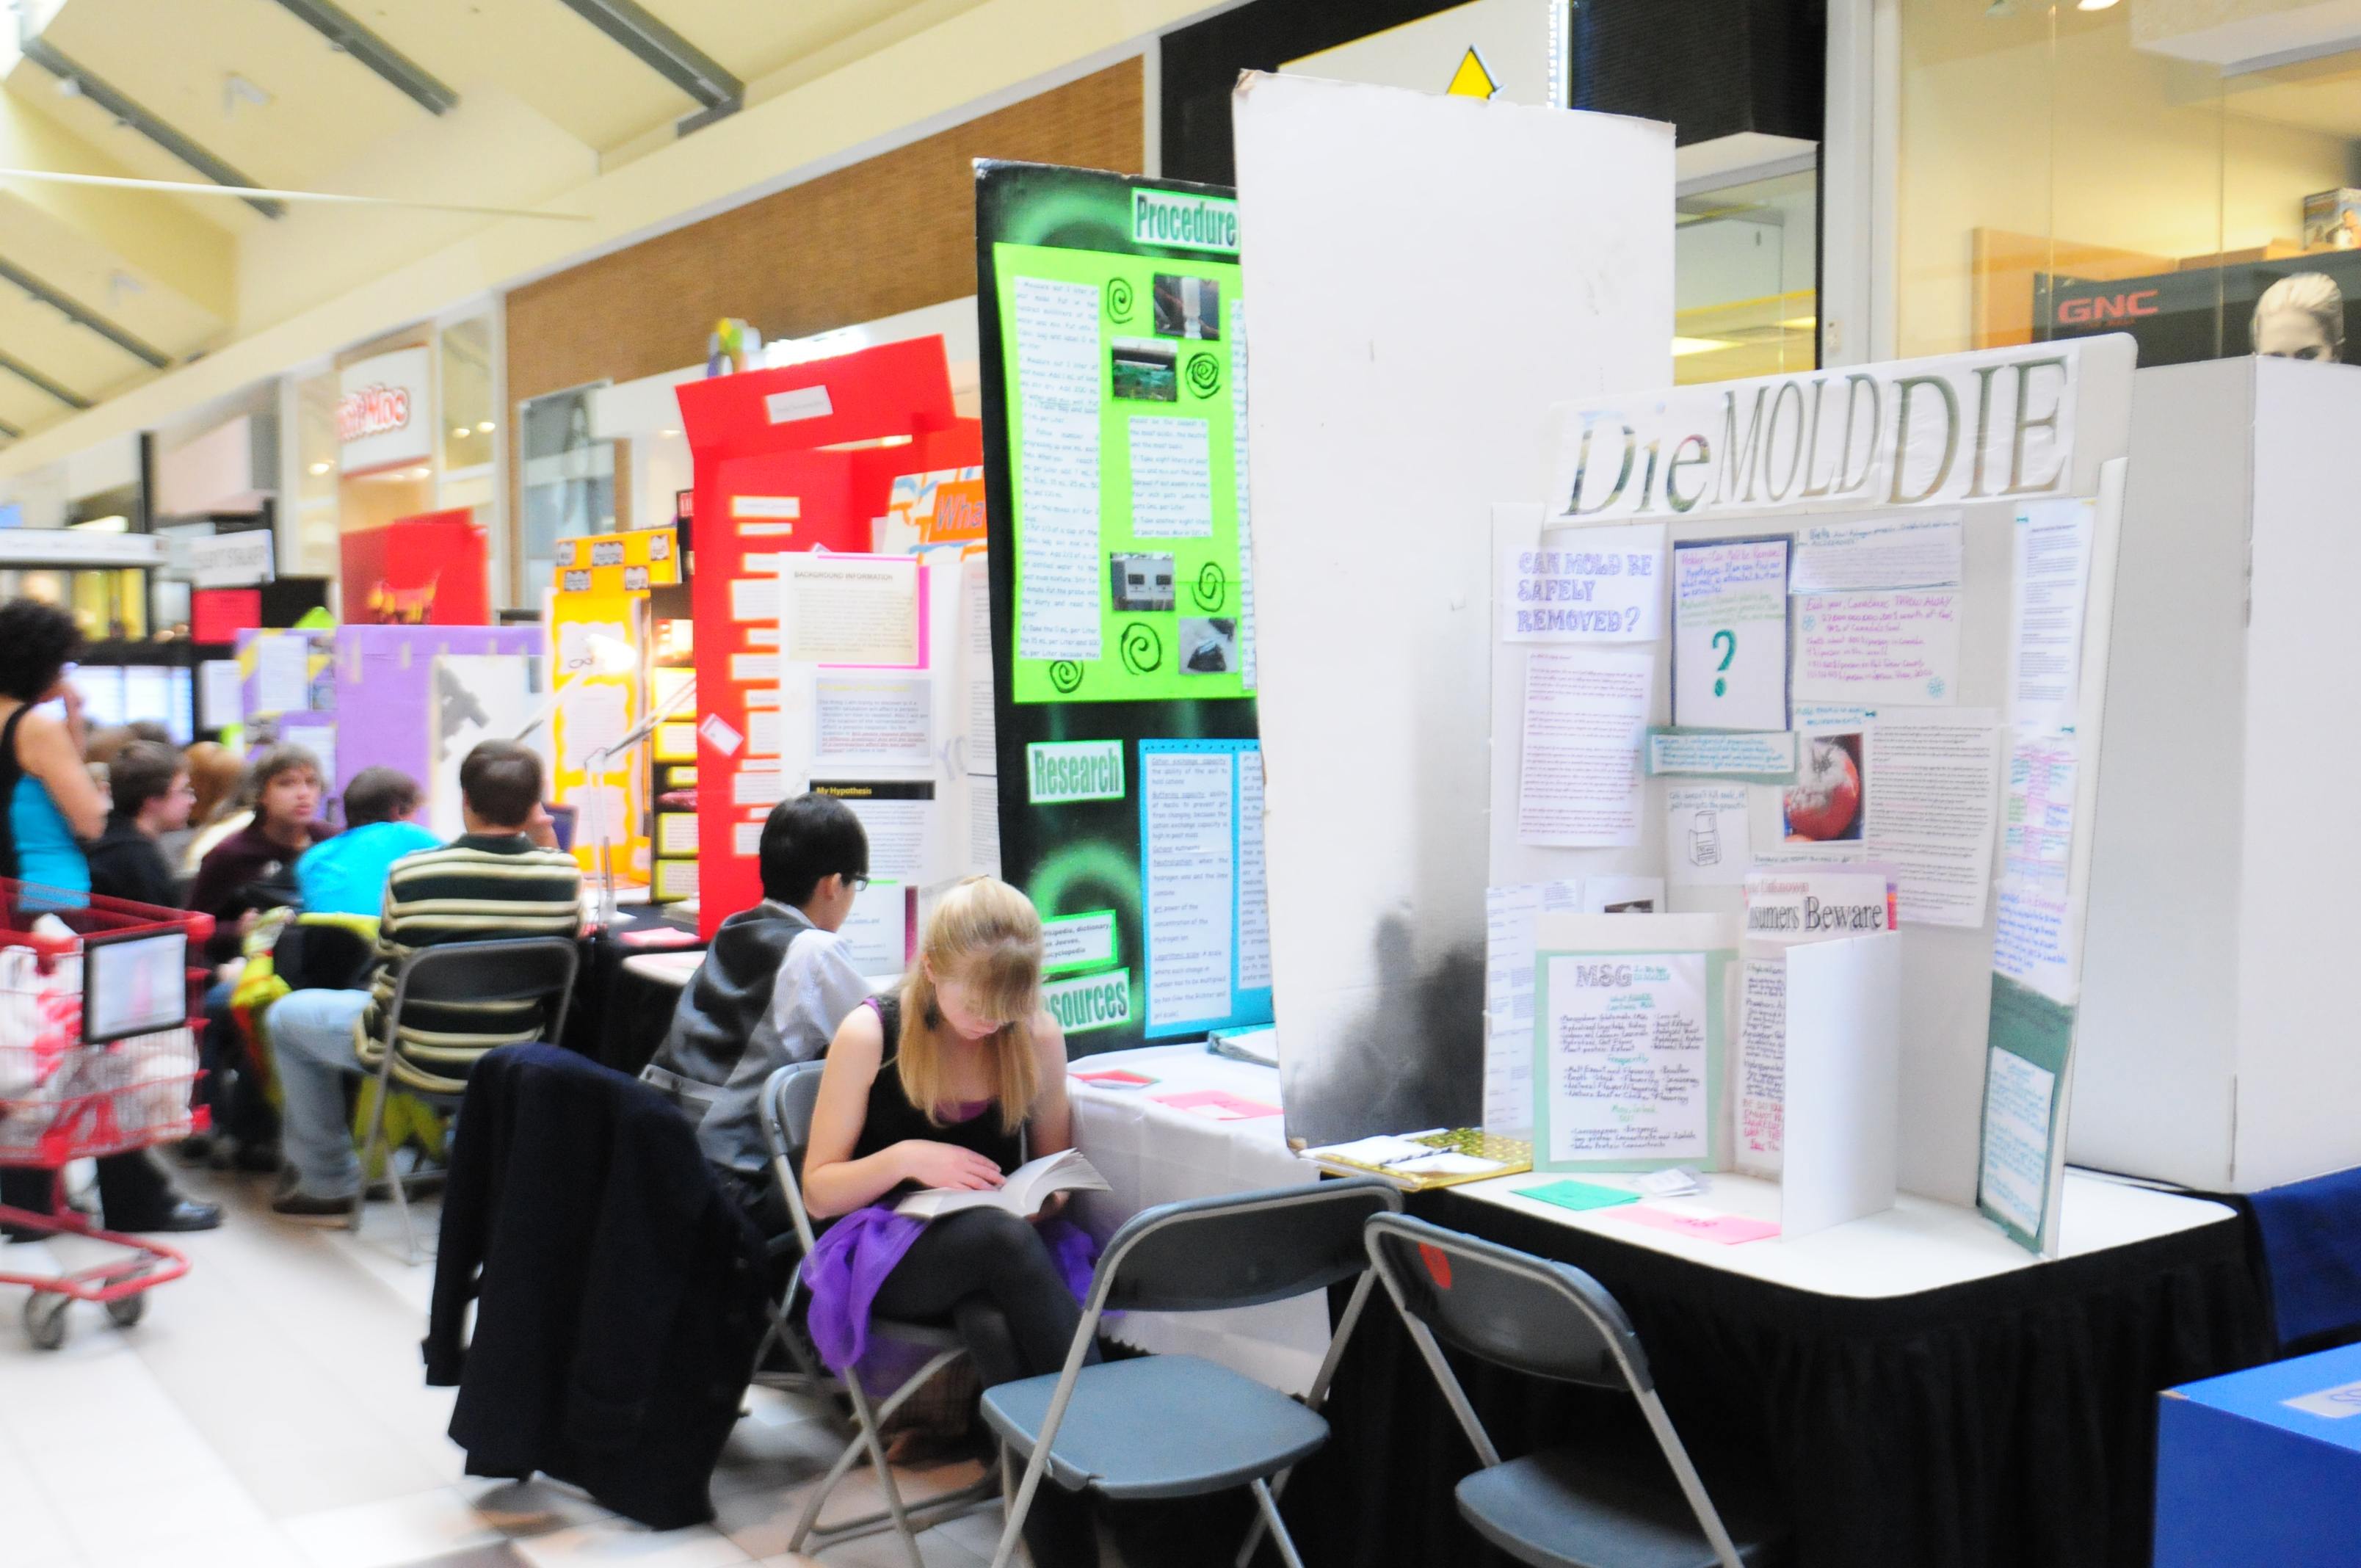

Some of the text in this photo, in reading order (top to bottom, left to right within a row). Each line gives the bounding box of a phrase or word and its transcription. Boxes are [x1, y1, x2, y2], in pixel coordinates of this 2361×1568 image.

[1136, 193, 1236, 247] Procedure
[2059, 289, 2159, 324] GNC
[1560, 356, 2068, 515] Die MOLD DIE
[794, 570, 893, 581] BACKGROUND INFORMATION
[1518, 552, 1653, 576] CAN MOLD BE
[1517, 579, 1596, 601] SAFELY
[1517, 606, 1641, 633] REMOVED?
[1034, 747, 1120, 795] Research
[830, 787, 872, 796] Hypothesis
[1803, 896, 1883, 932] Beware
[1575, 963, 1633, 987] MSG
